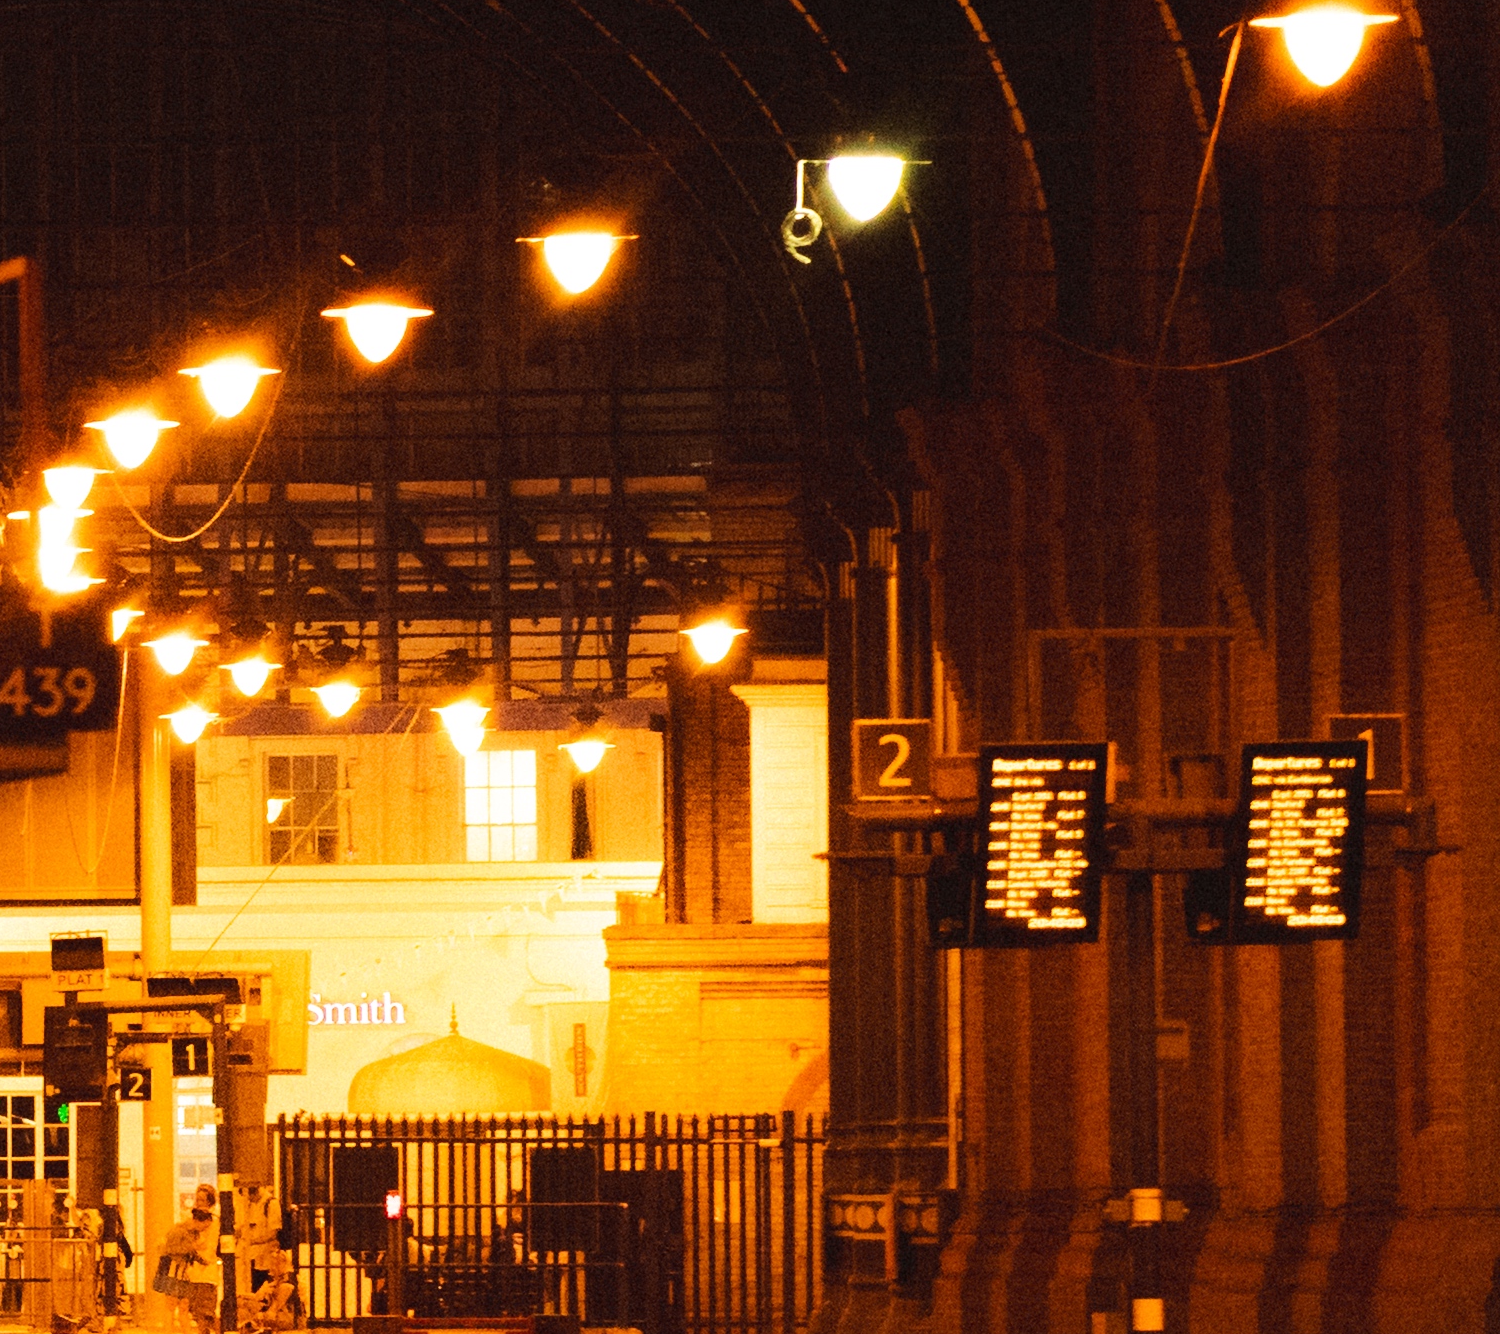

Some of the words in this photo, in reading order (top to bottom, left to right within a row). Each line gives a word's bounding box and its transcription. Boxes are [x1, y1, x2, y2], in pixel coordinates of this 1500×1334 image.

[879, 733, 912, 787] 2
[993, 758, 1063, 772] Departures
[1252, 757, 1323, 771] Departures
[1358, 729, 1375, 780] 1
[58, 974, 92, 985] PLAT
[186, 1044, 195, 1071] 1
[129, 1072, 144, 1097] 2
